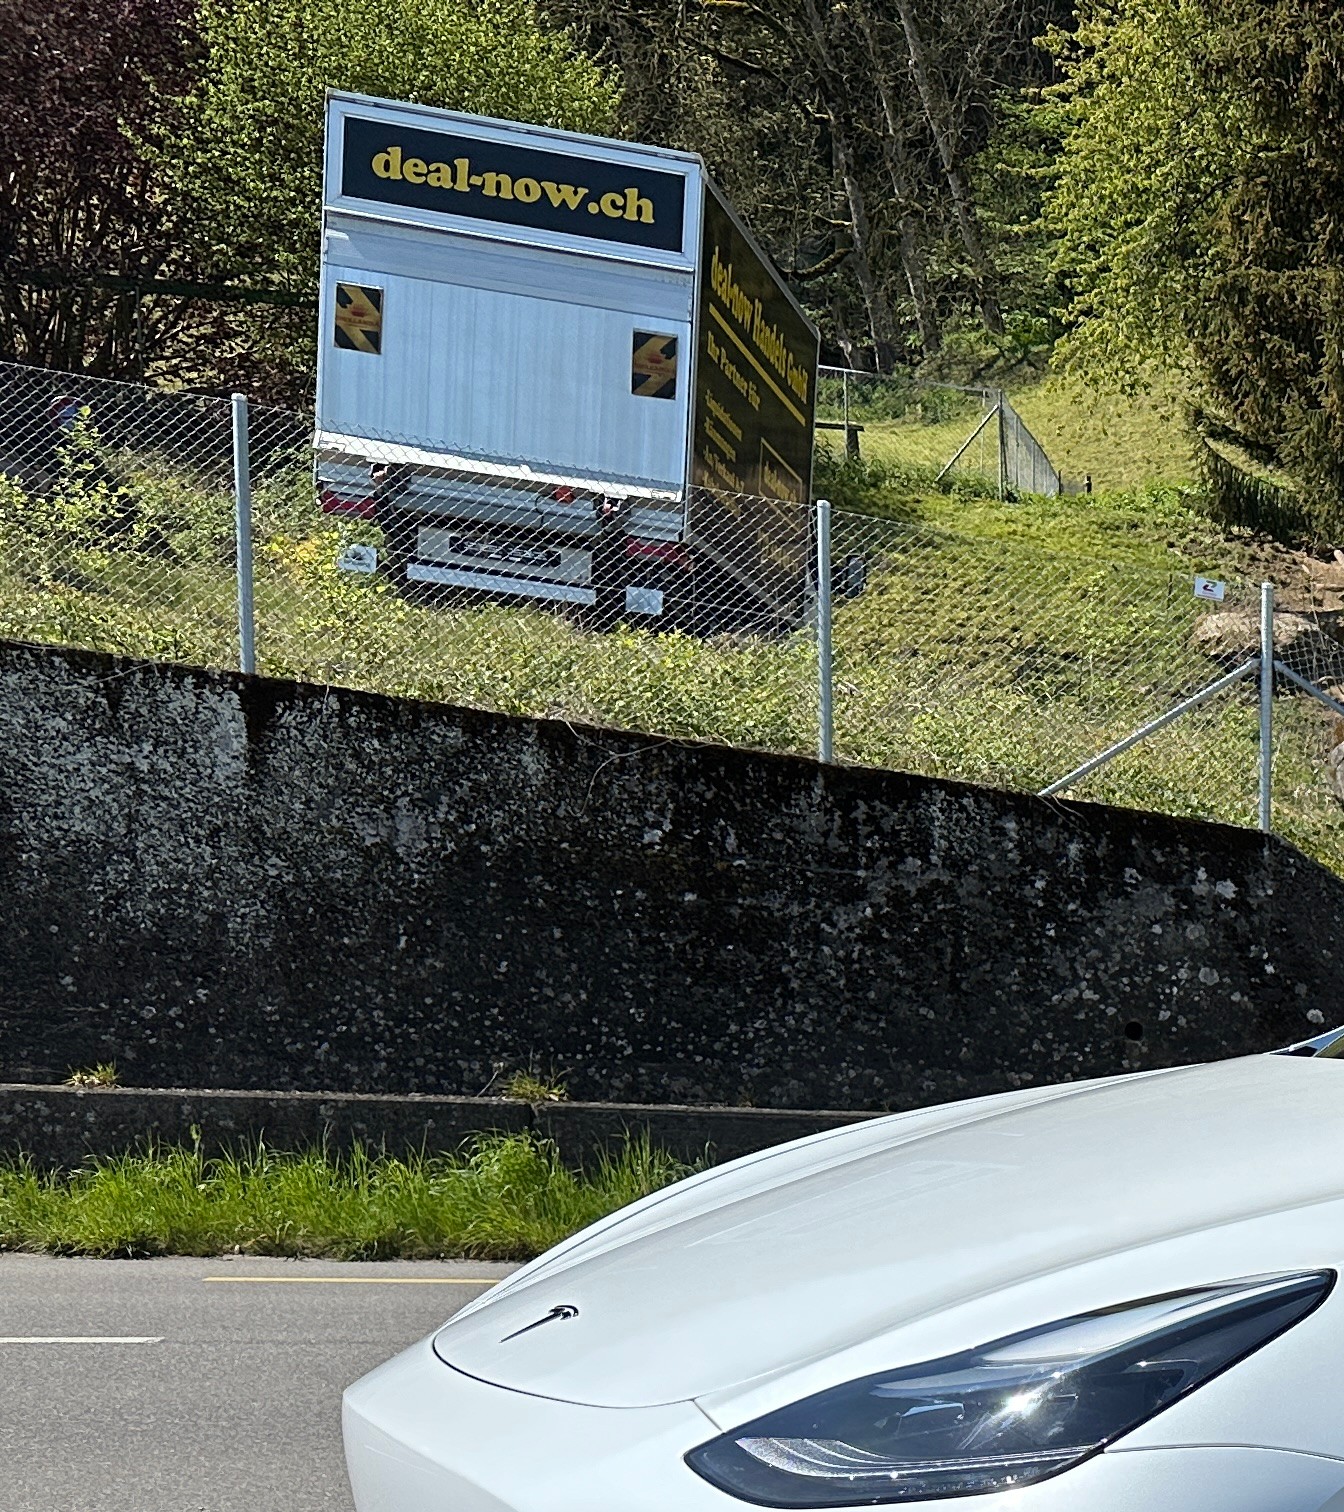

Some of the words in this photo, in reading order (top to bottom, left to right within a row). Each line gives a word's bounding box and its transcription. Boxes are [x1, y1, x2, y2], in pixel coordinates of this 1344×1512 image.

[371, 146, 656, 224] deal-now.ch
[710, 245, 753, 333] deal-now
[752, 298, 787, 378] Handels
[720, 346, 748, 397] Partner
